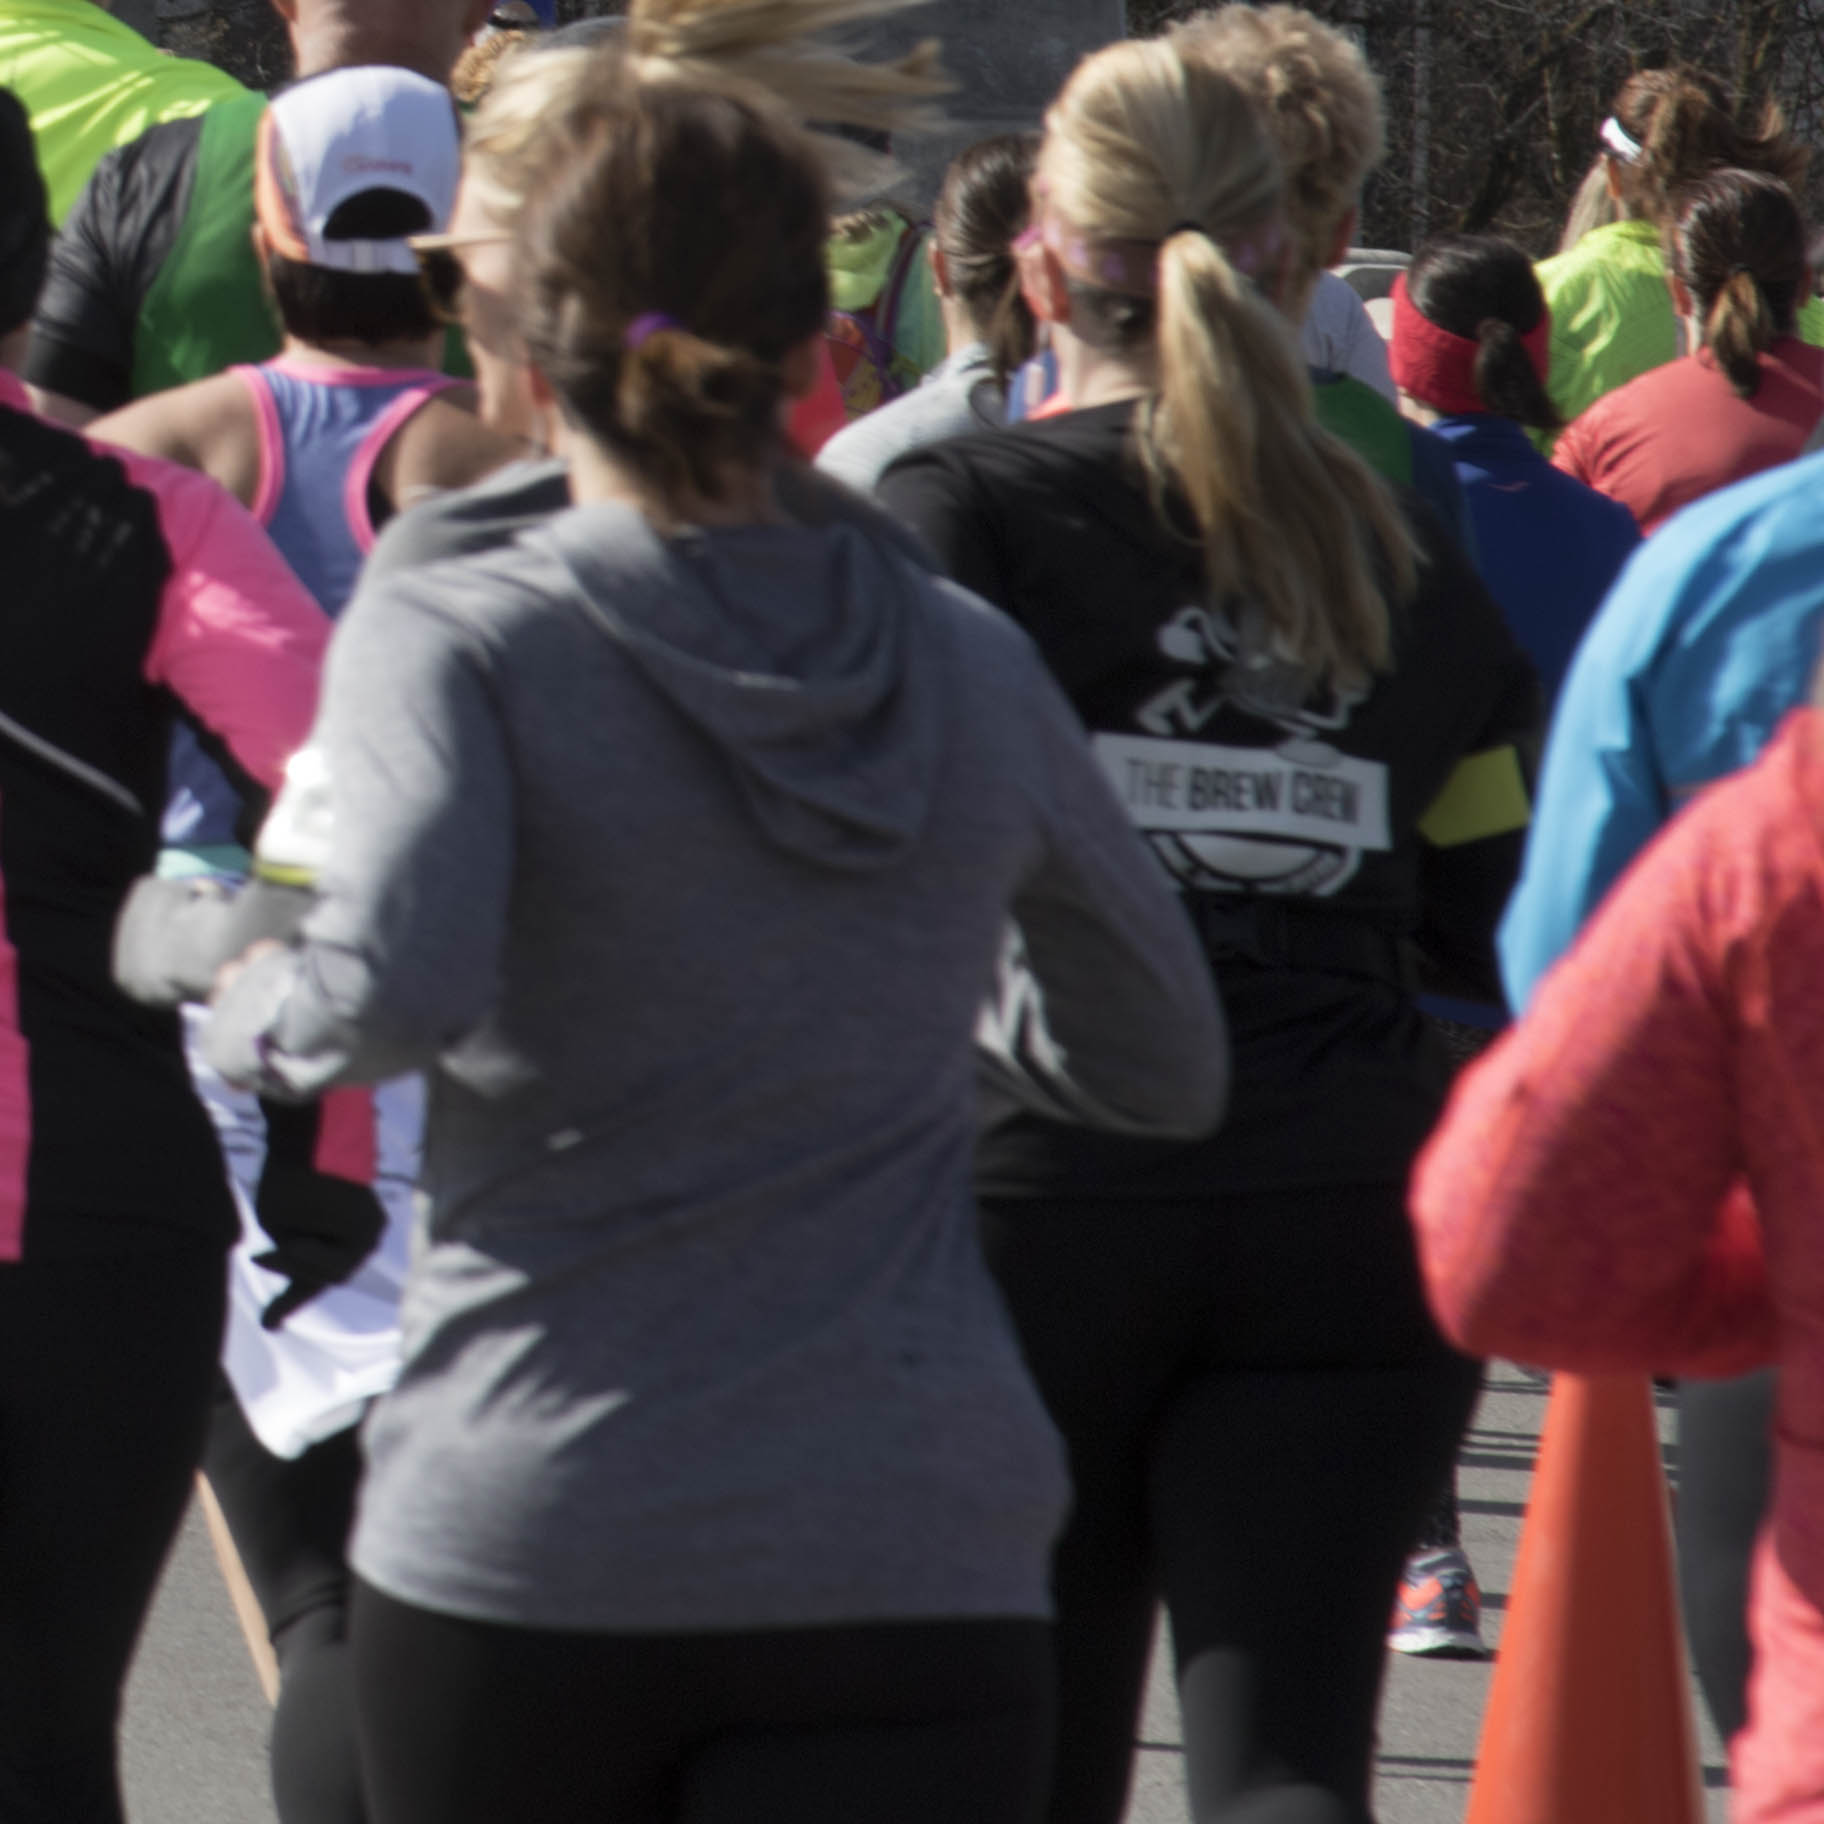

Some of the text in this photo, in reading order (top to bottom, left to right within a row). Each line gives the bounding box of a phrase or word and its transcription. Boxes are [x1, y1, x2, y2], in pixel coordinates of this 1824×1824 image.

[1124, 757, 1361, 825] THE BREW CREW
